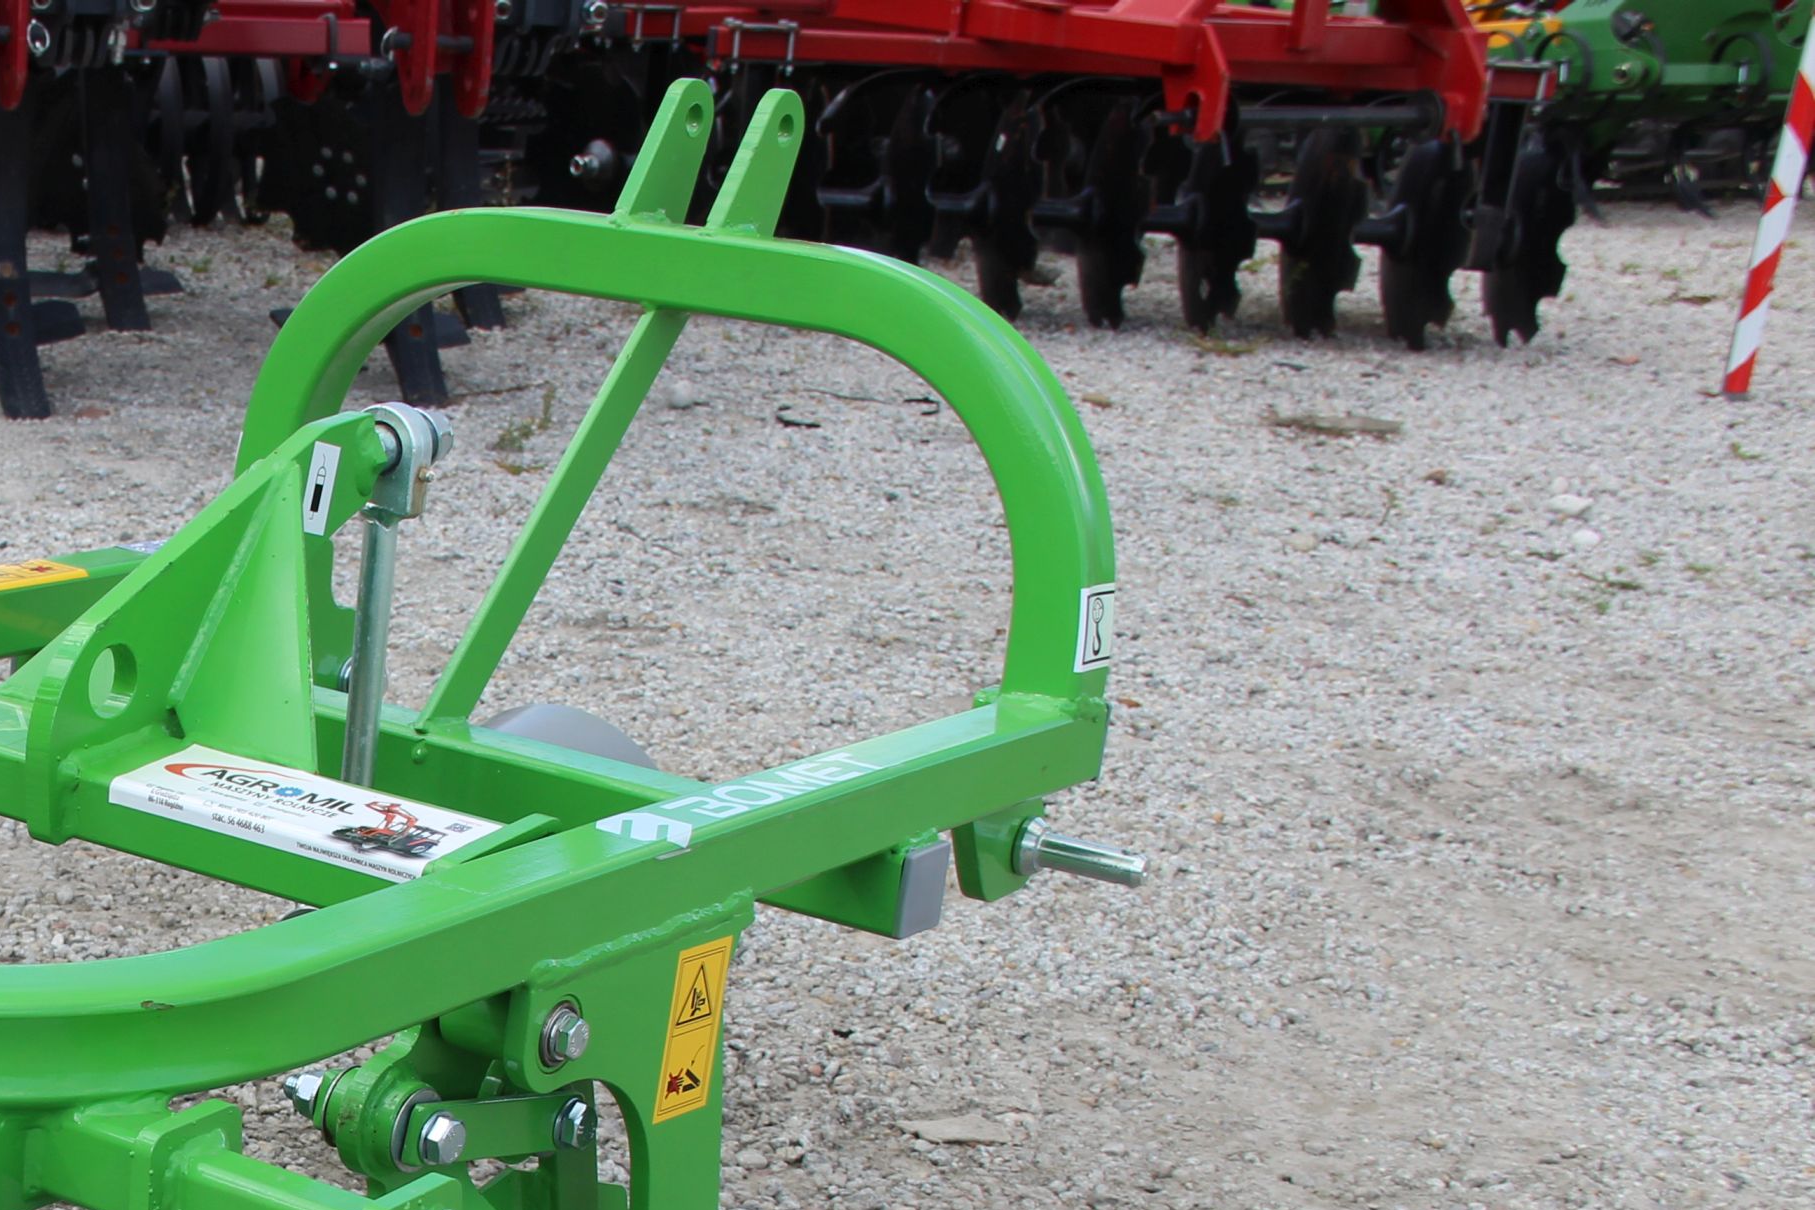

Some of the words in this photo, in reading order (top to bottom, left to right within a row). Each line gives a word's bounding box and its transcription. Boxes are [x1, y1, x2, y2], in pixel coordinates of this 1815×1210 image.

[210, 782, 272, 801] MASZYNY
[272, 798, 339, 819] ROLNICZE
[661, 752, 884, 818] BOMET
